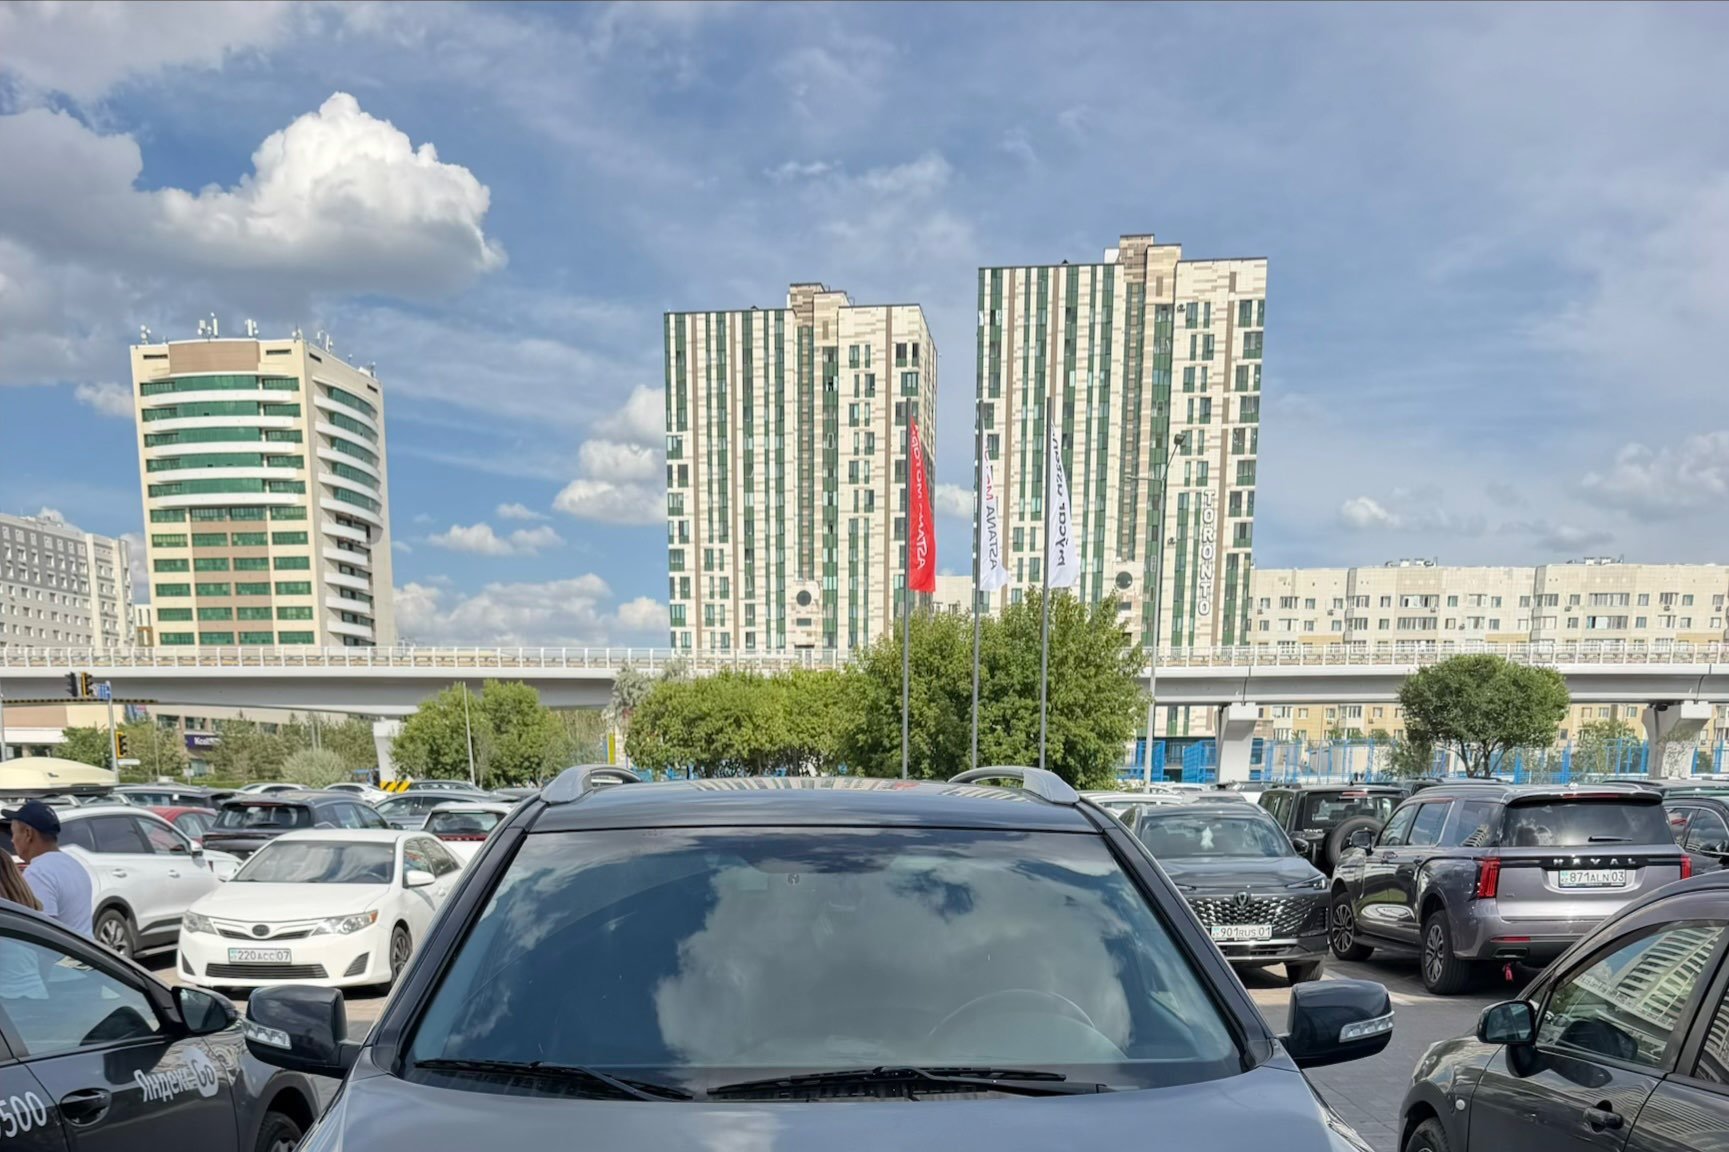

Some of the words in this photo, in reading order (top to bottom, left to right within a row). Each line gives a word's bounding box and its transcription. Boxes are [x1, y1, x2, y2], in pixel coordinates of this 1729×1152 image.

[1198, 489, 1215, 616] TORONTO
[190, 1058, 216, 1088] Go
[0, 1090, 48, 1138] 500
